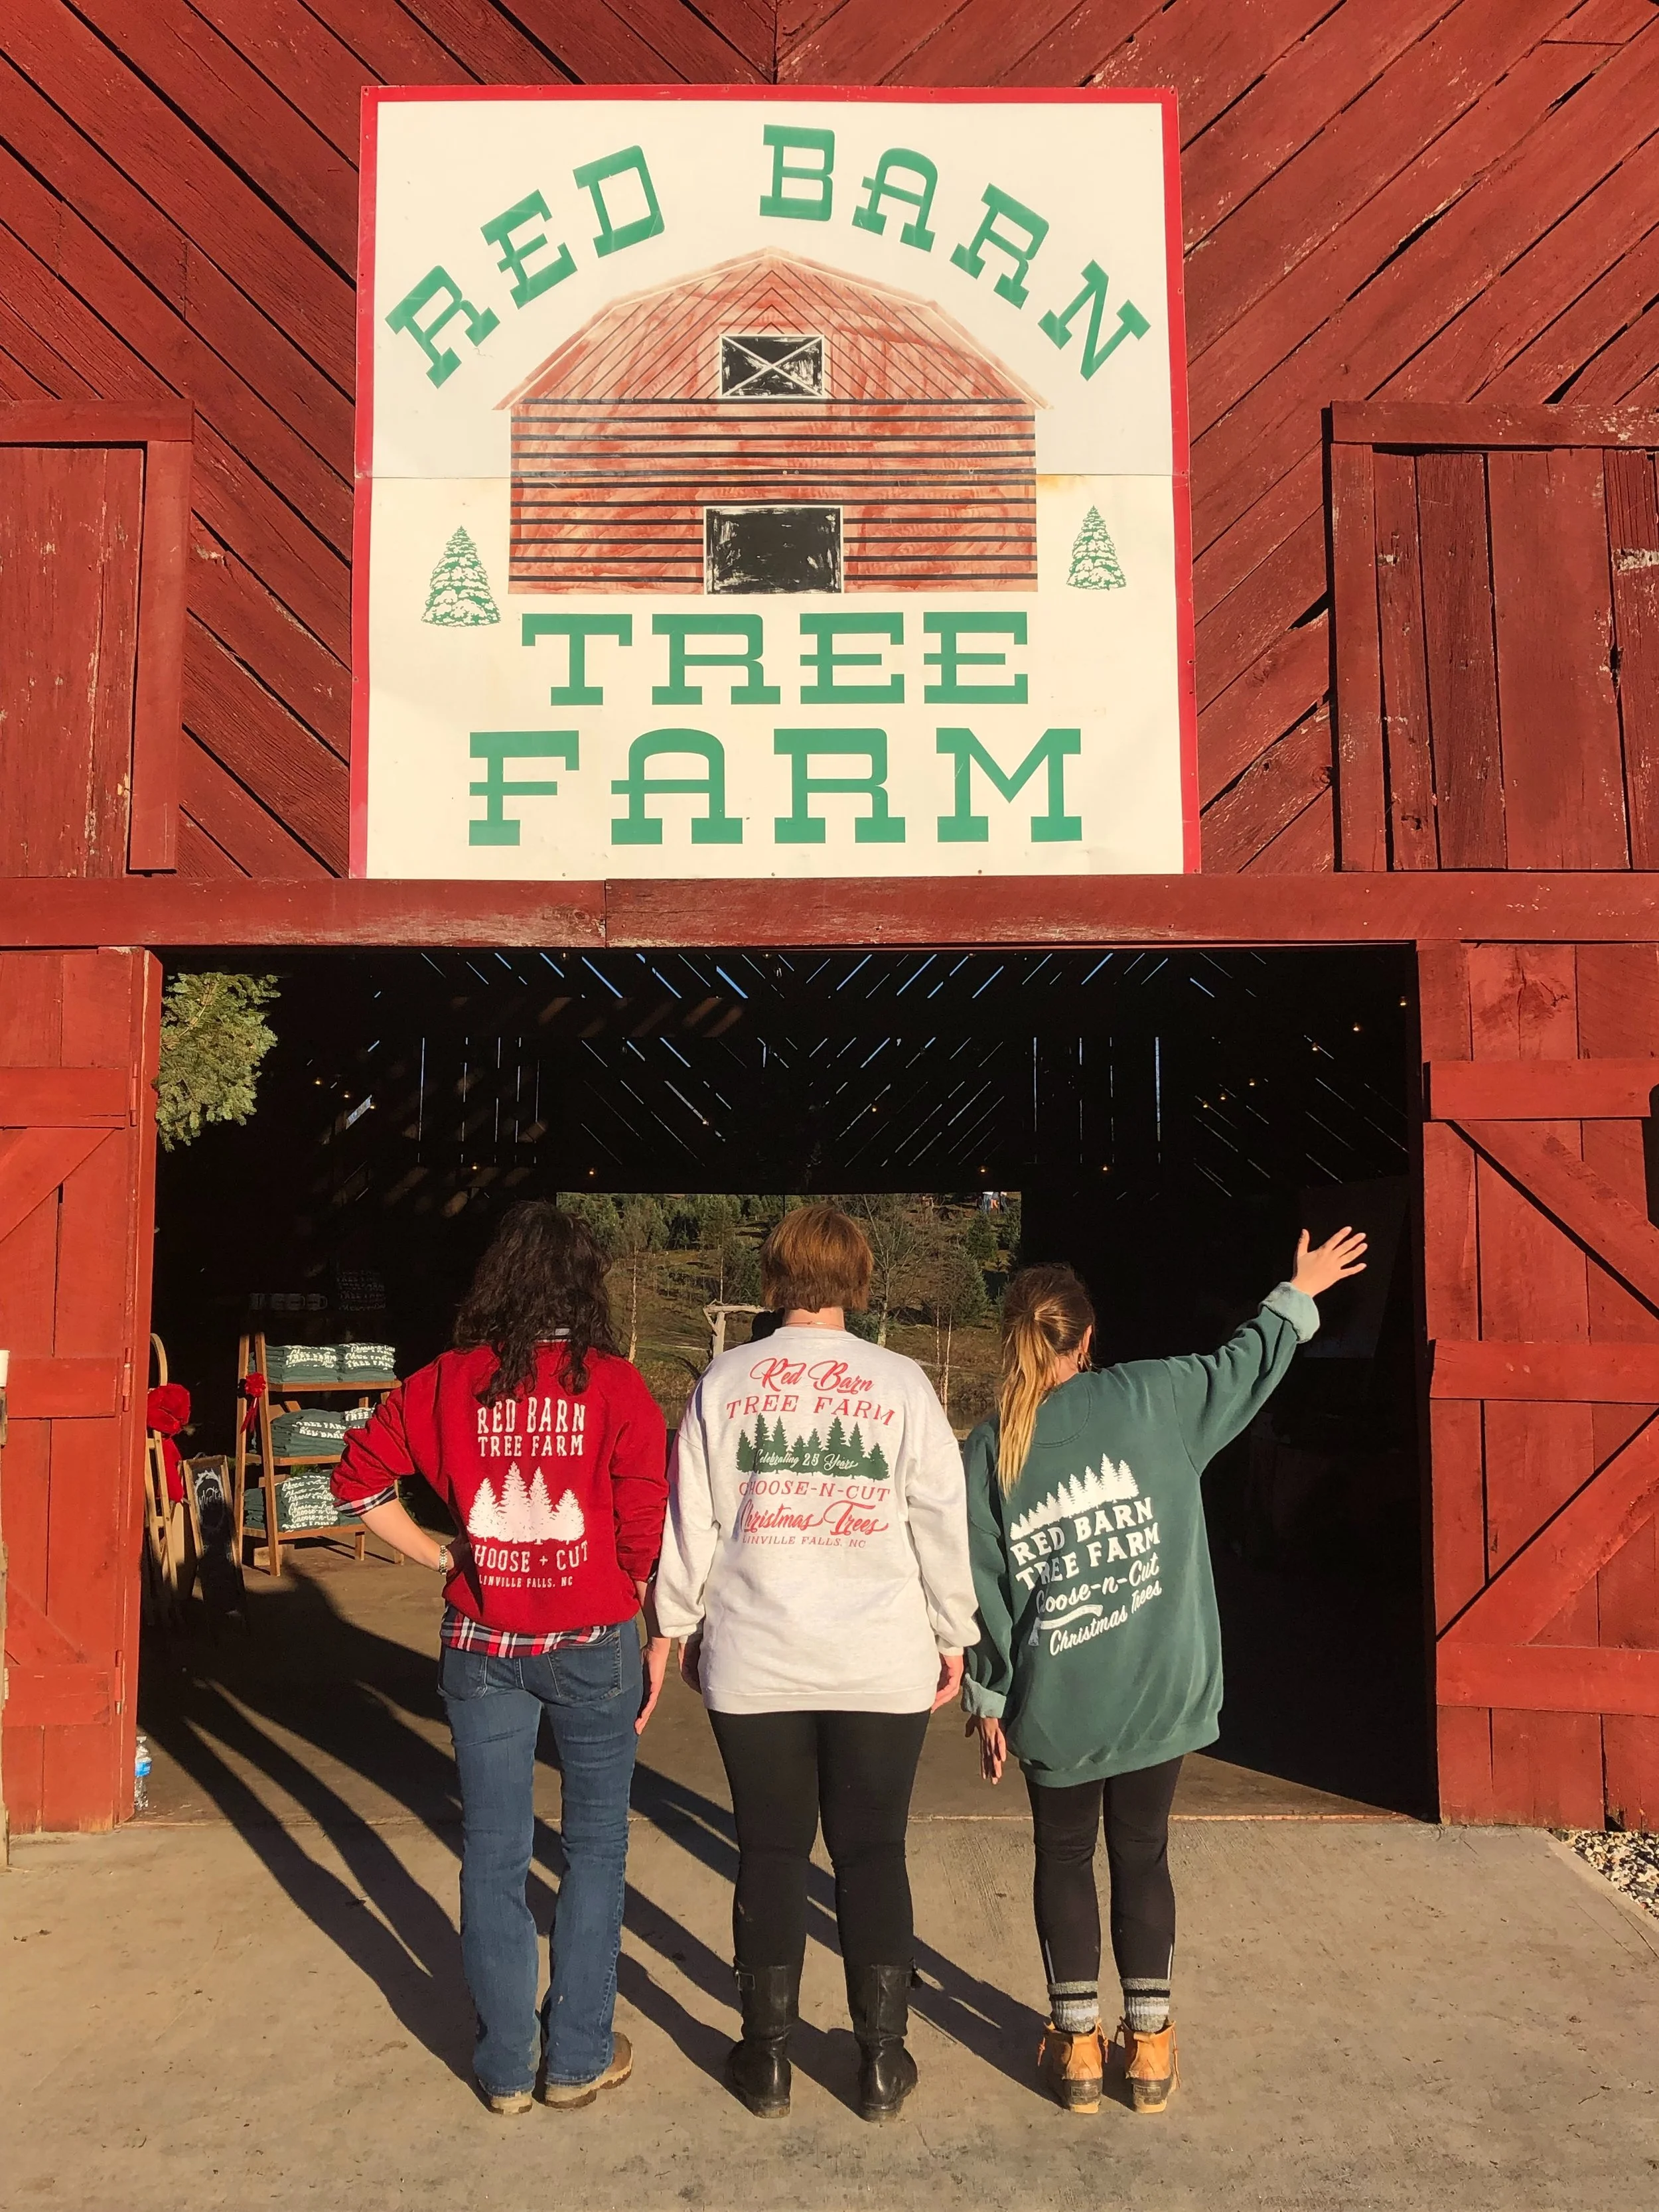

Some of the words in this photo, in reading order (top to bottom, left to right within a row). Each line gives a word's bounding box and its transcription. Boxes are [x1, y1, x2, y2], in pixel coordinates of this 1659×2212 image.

[385, 145, 665, 389] RED
[760, 124, 1151, 381] BARN
[522, 611, 1029, 706] TREE
[469, 727, 1082, 846] FARM
[749, 1358, 807, 1392] Red
[808, 1360, 875, 1394] Barn
[477, 1398, 516, 1434] RED
[527, 1396, 586, 1433] BARN
[726, 1394, 799, 1420] TREE
[813, 1396, 895, 1426] FARM
[478, 1435, 522, 1457] TREE
[531, 1434, 584, 1457] FARM
[756, 1449, 800, 1468] Celebrating
[802, 1452, 820, 1466] 25
[824, 1453, 859, 1471] Years
[739, 1480, 891, 1502] CHOOSE-N-CUT
[741, 1499, 824, 1533] Christmas
[823, 1500, 889, 1536] Trees
[1010, 1526, 1065, 1566] RED
[1074, 1497, 1153, 1542] BARN
[470, 1543, 530, 1573] HOOSE
[555, 1540, 588, 1571] CUT
[849, 1539, 866, 1548] NC
[1015, 1551, 1079, 1591] TREE
[1086, 1522, 1161, 1567] FARM
[478, 1574, 522, 1588] LINVILLE
[561, 1576, 573, 1587] NC
[1036, 1552, 1159, 1613] Coose-n-Cut
[1050, 1605, 1127, 1656] Christmas
[1131, 1580, 1162, 1614] Trees
